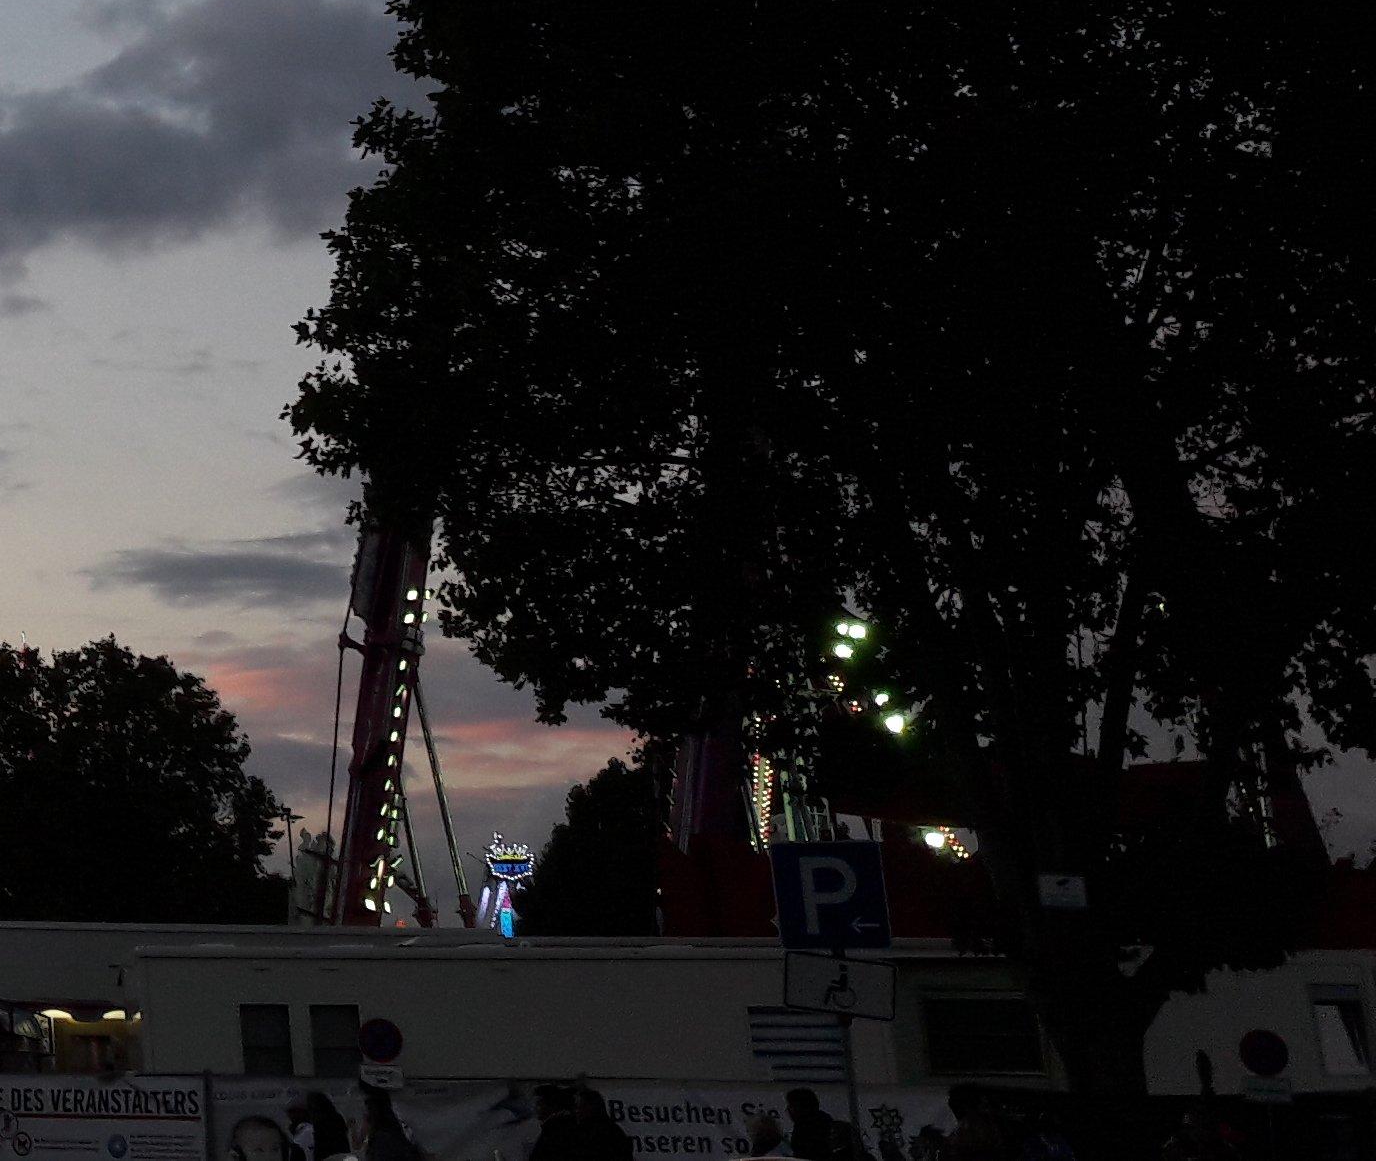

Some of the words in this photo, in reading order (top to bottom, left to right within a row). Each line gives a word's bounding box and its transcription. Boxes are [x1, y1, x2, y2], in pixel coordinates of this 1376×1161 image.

[799, 855, 857, 935] P
[11, 1087, 44, 1113] DES
[50, 1088, 199, 1115] VERANSTALTERS
[609, 1100, 732, 1125] Besuchen
[630, 1133, 712, 1155] nseren
